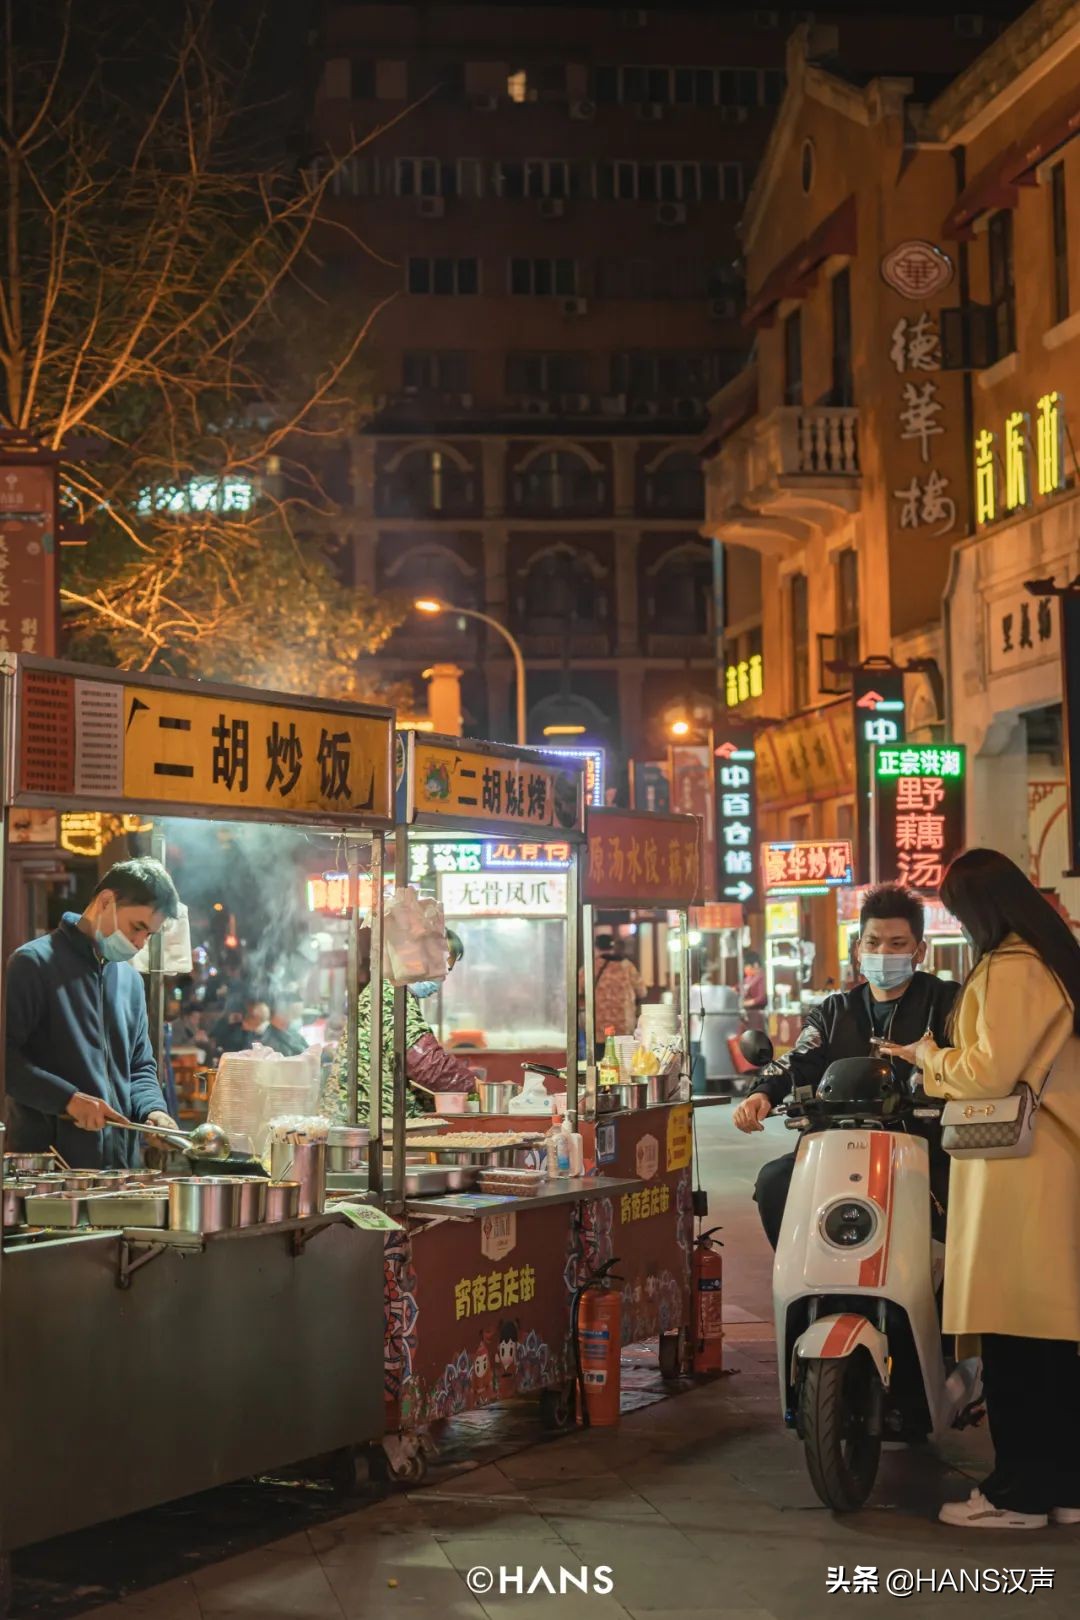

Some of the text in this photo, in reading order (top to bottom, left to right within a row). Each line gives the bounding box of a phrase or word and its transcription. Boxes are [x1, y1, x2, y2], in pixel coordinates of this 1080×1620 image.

[153, 713, 353, 799] 二胡炒饭
[878, 748, 961, 777] 正宗洪湖
[457, 766, 547, 820] 二胡烧烤
[895, 776, 945, 888] 野藕汤
[458, 879, 550, 907] 无骨凤爪
